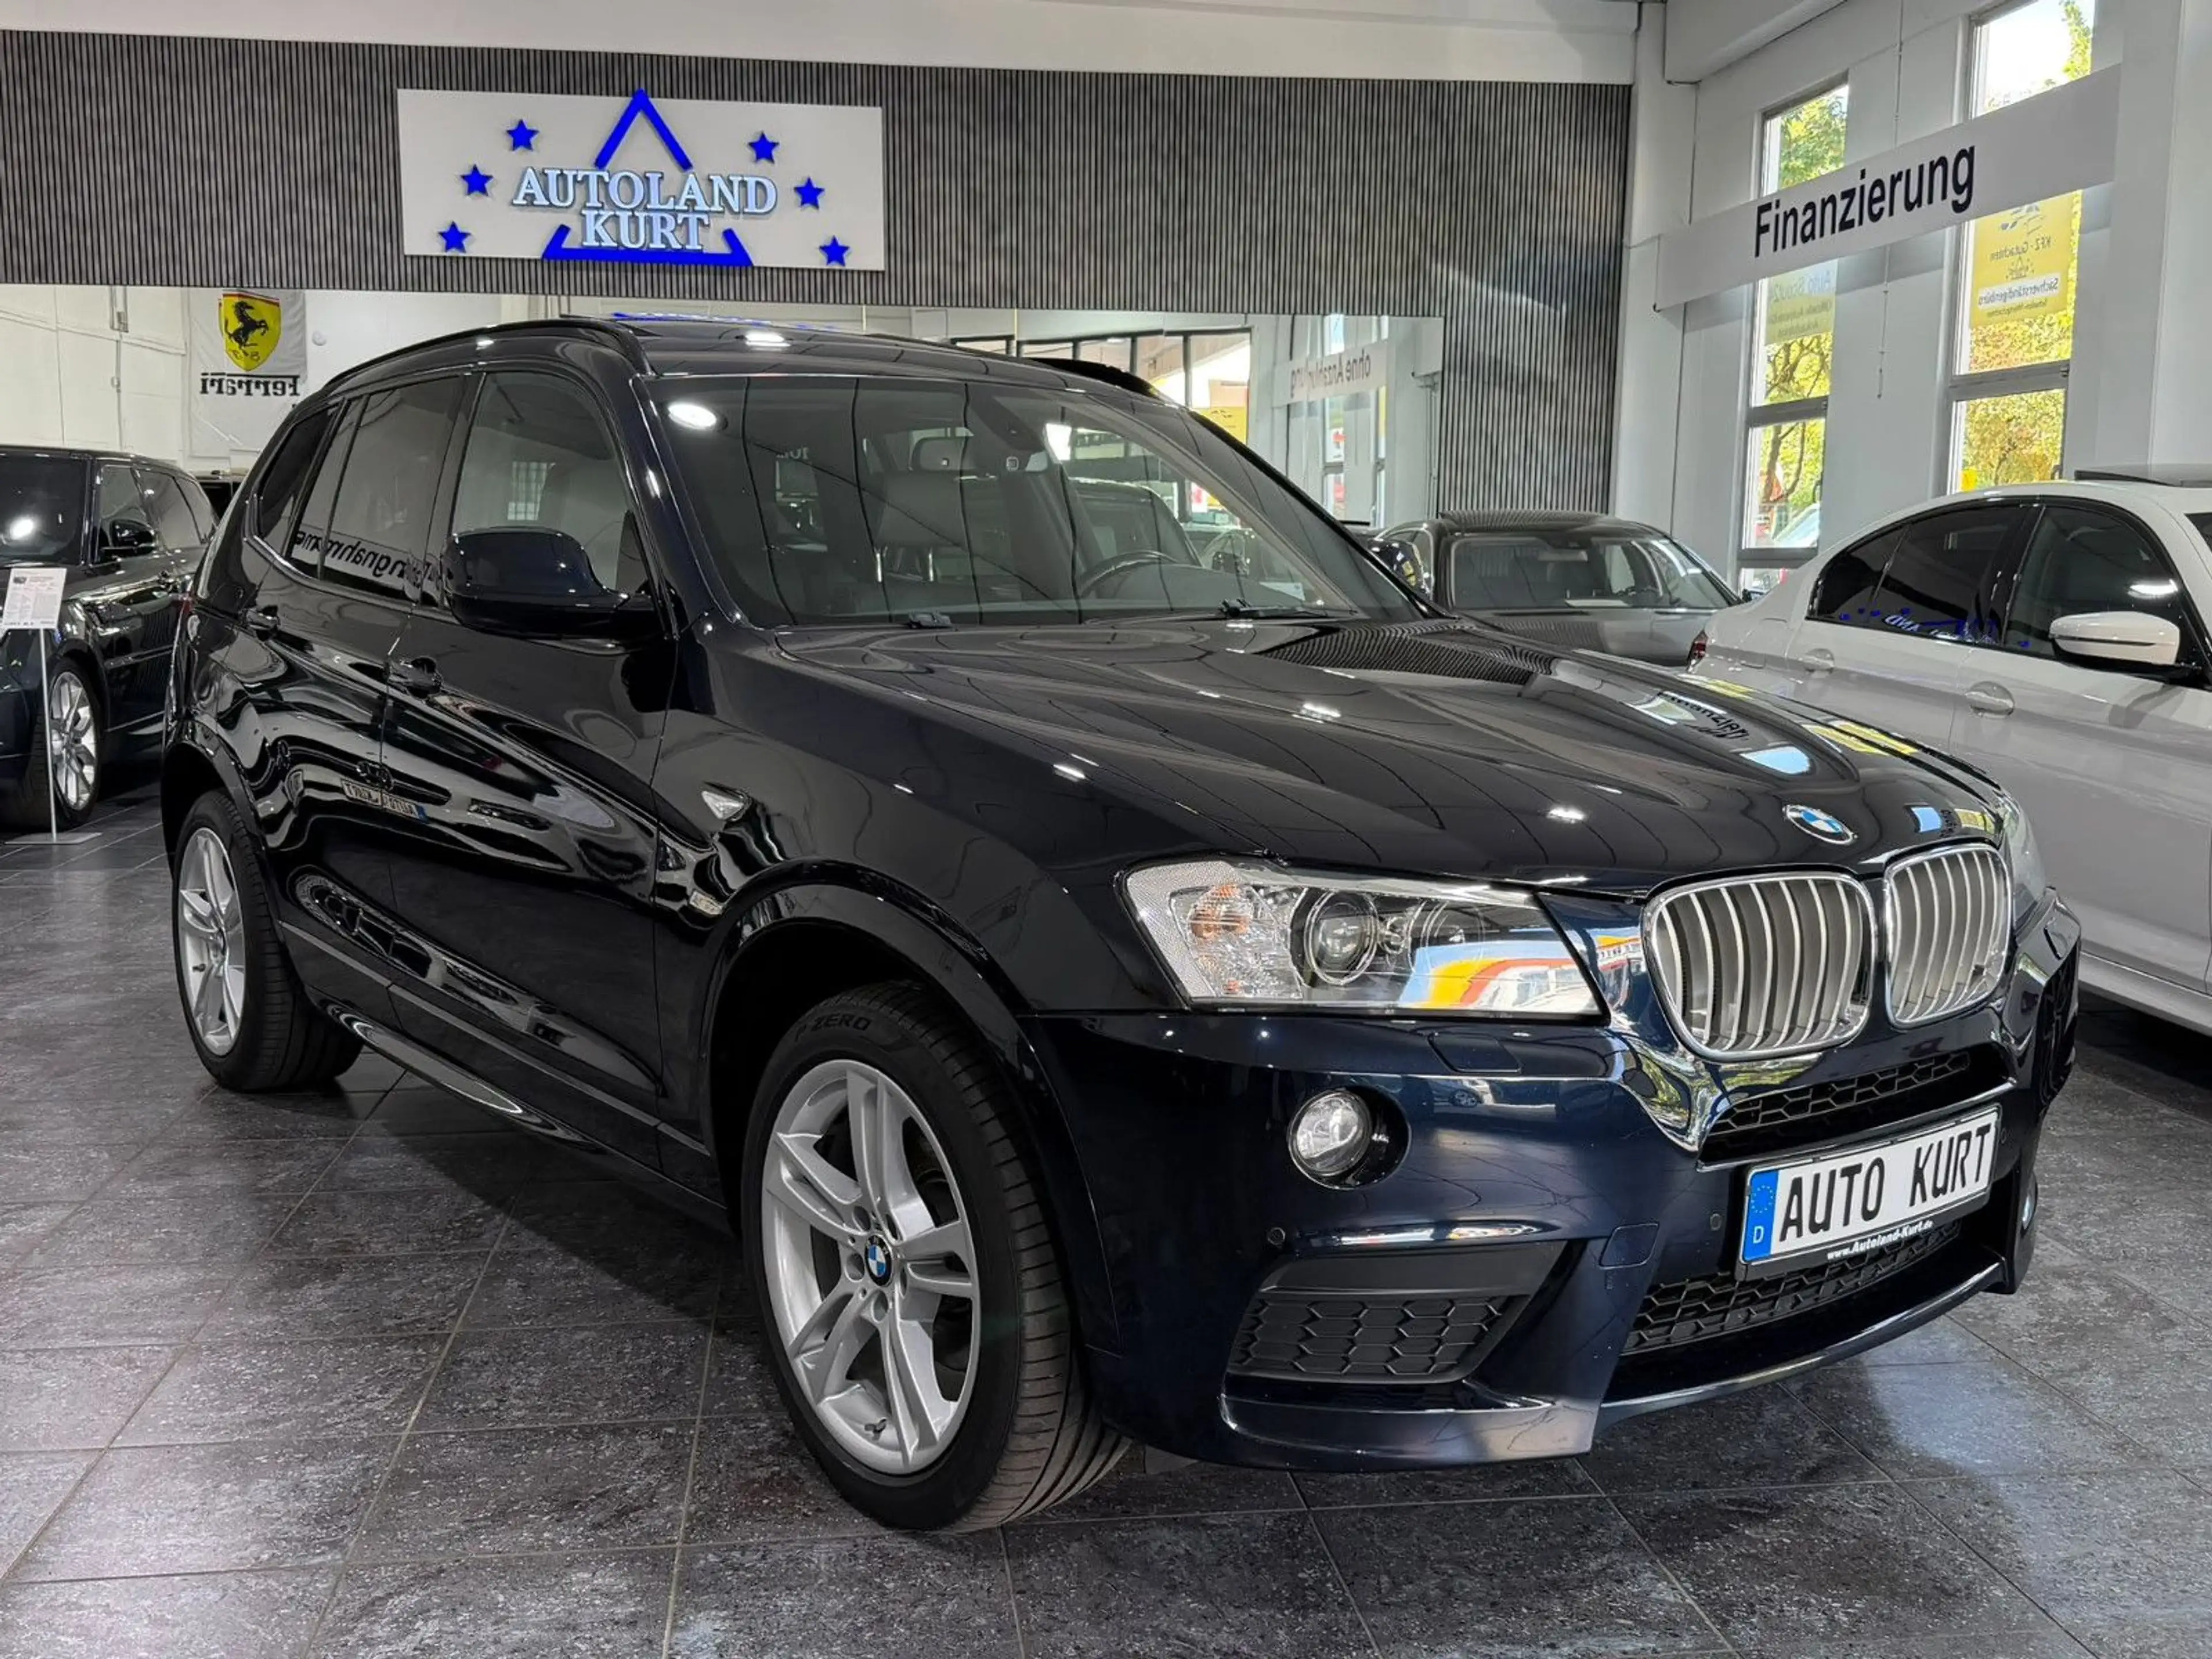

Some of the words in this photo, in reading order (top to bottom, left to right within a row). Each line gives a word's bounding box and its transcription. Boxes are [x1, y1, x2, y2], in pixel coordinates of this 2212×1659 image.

[512, 167, 778, 216] AUTOLAND
[1754, 145, 1976, 258] Finanzierung
[581, 209, 710, 251] KURT
[810, 1012, 873, 1032] ZERO
[1779, 1157, 1885, 1243] AUTO
[1909, 1123, 1993, 1208] KURT
[1752, 1225, 1765, 1244] D
